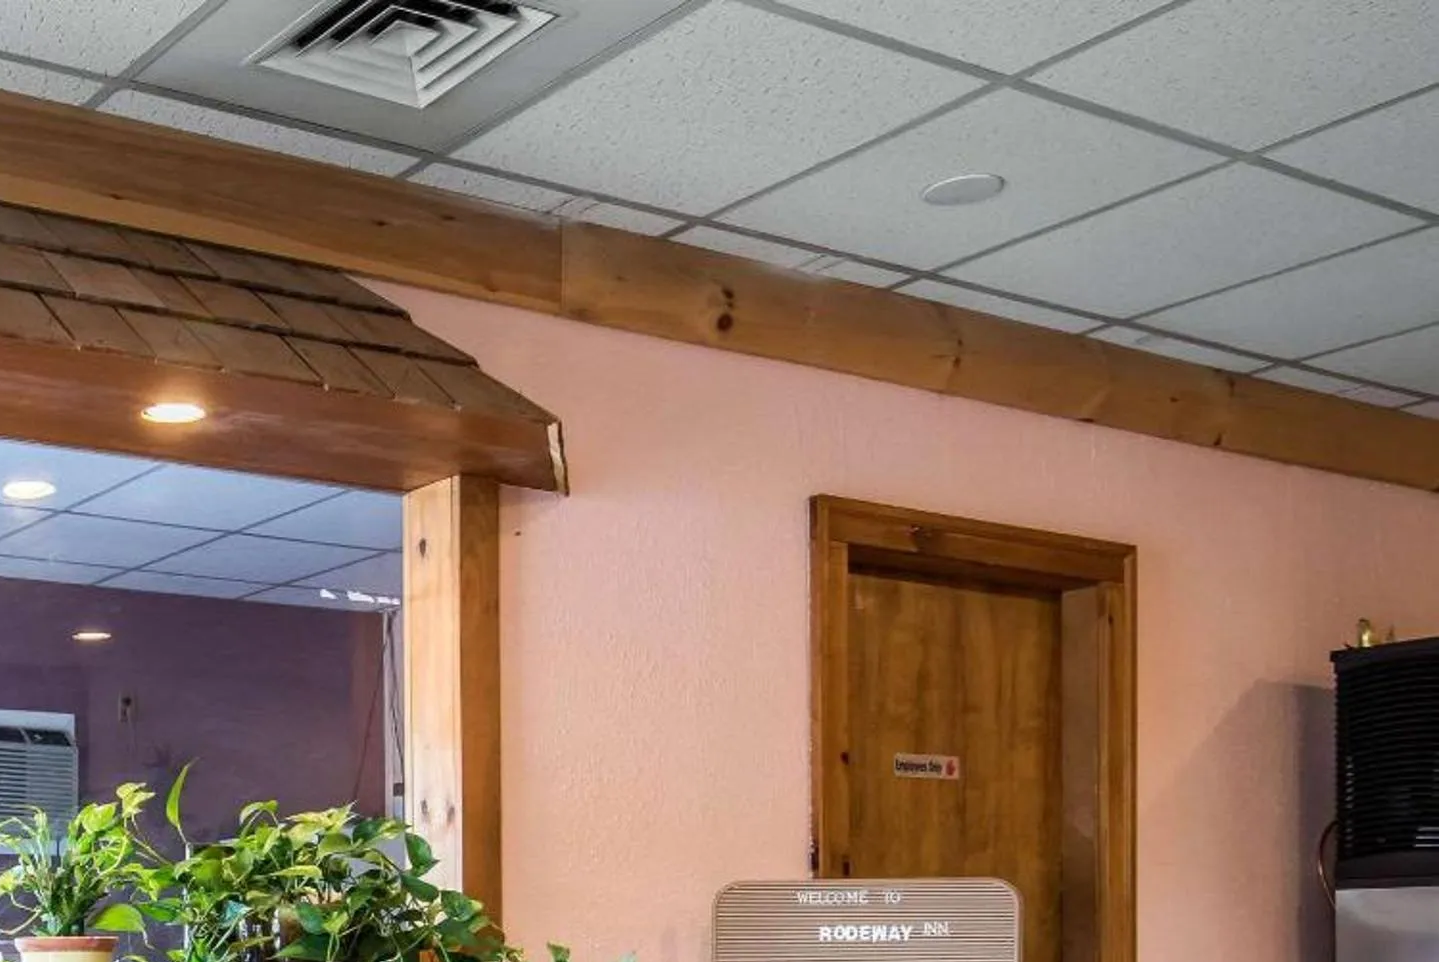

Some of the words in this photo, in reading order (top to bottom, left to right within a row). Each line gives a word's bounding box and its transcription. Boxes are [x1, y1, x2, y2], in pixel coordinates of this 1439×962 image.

[796, 890, 870, 905] WELCOME
[883, 890, 902, 905] TO
[818, 924, 913, 943] RODEWAY
